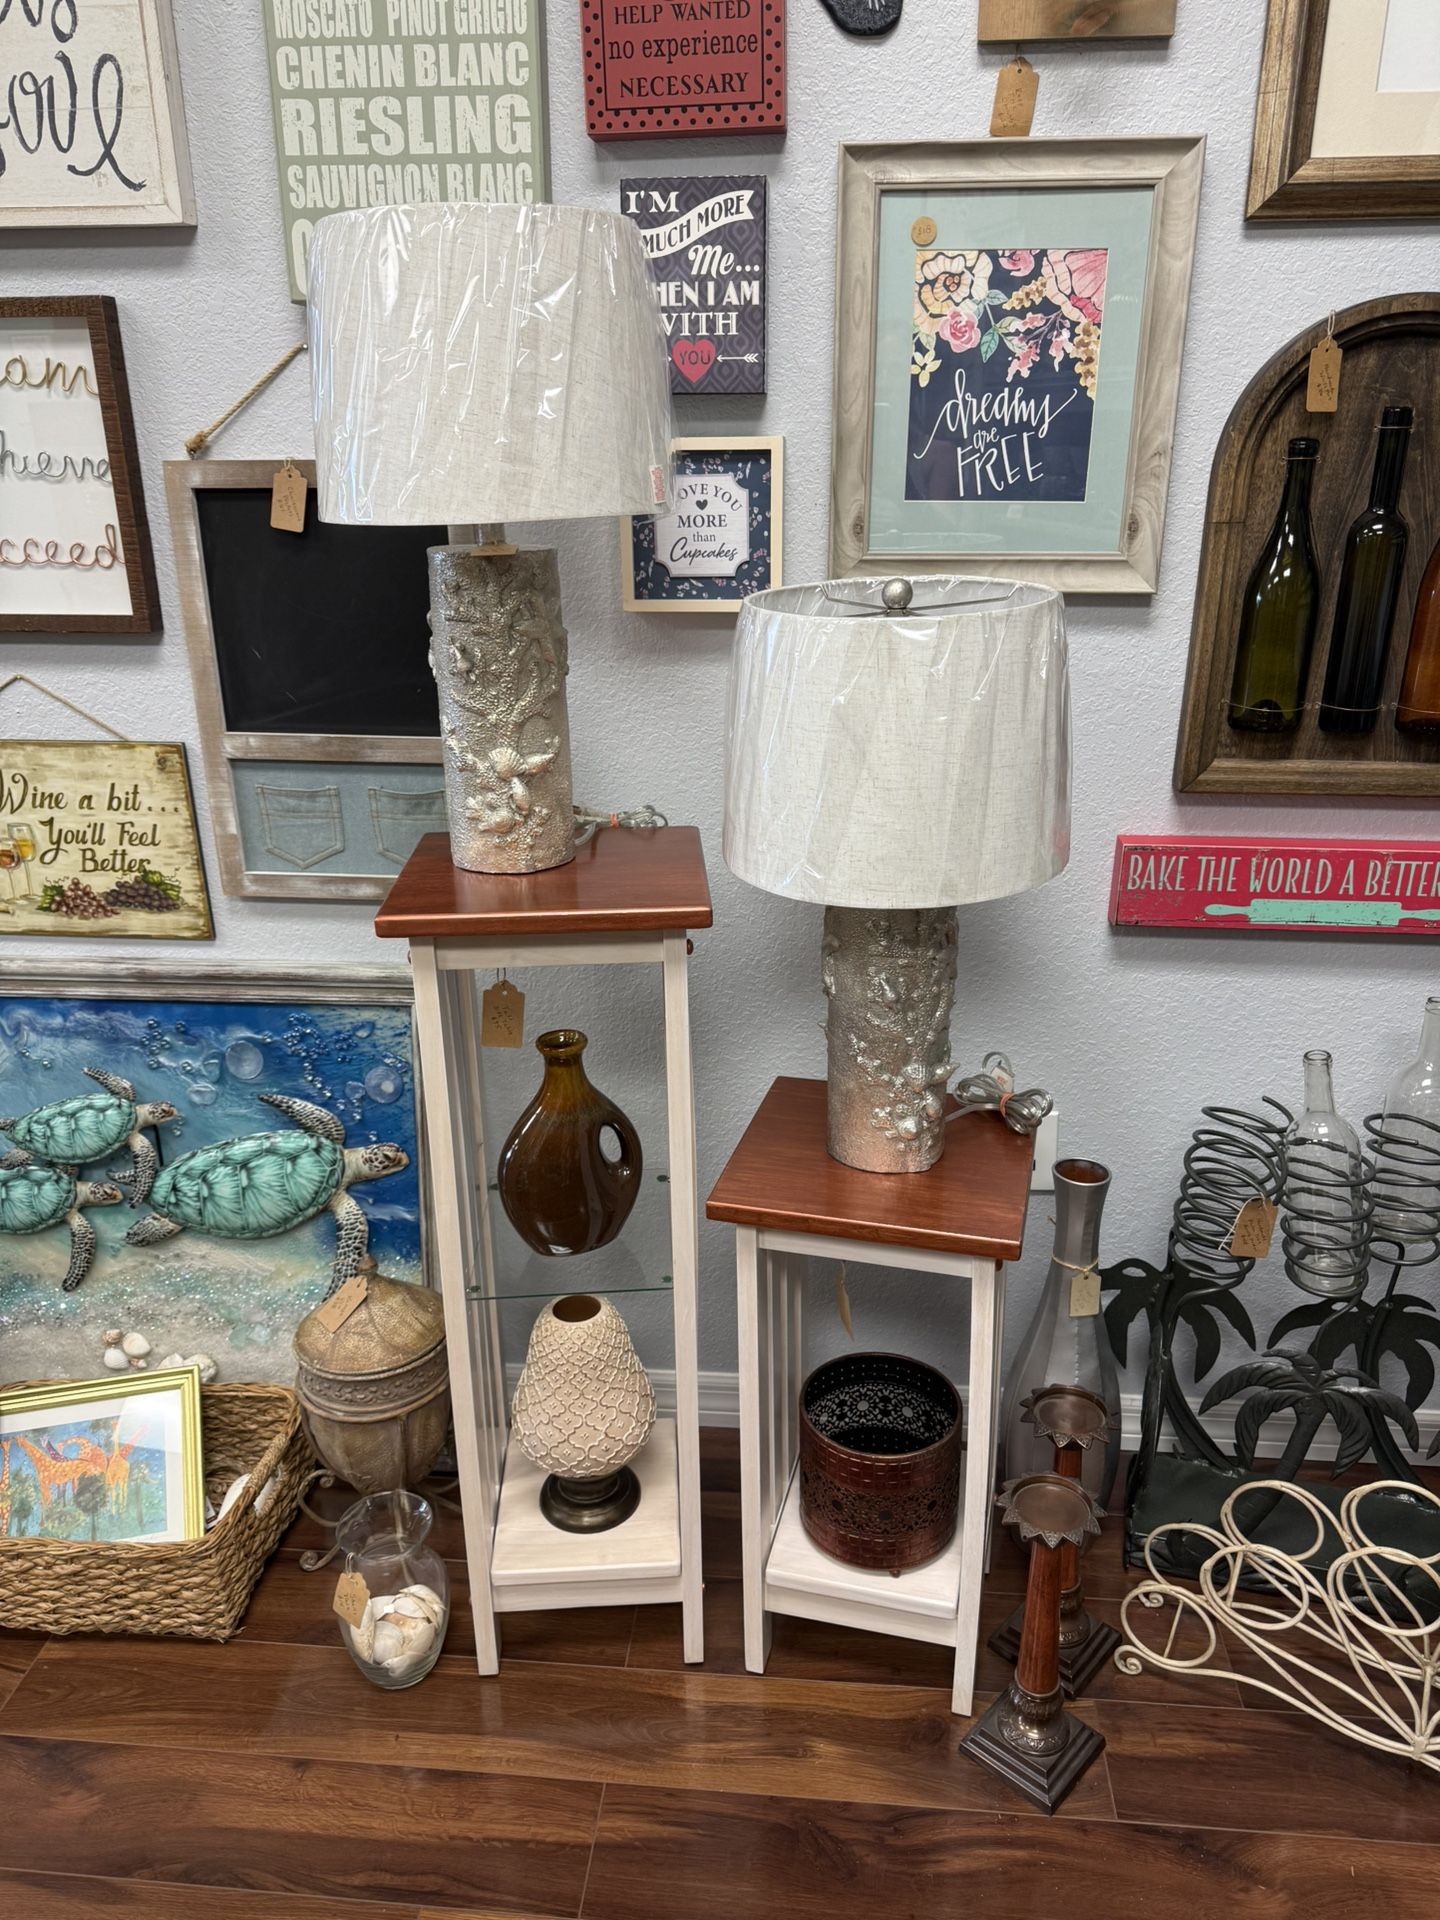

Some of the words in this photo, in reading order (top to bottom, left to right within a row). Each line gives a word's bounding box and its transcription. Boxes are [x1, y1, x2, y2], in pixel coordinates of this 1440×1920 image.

[273, 0, 373, 38] MOSCATO
[387, 0, 448, 37] PINOT
[453, 0, 528, 36] GRIGIO
[614, 4, 664, 25] HELP
[671, 0, 751, 22] WANTED
[608, 40, 634, 60] no
[642, 30, 759, 64] experience
[276, 44, 405, 90] CHENIN
[413, 41, 530, 87] BLANC
[620, 72, 750, 98] NECESSARY
[280, 94, 533, 156] RIESLING
[287, 163, 440, 208] SAUVIGNON
[446, 162, 534, 204] BLANC
[626, 190, 680, 214] I'M
[642, 219, 692, 253] MUCH
[697, 194, 746, 232] MORE
[657, 280, 699, 307] HEN
[707, 281, 715, 306] I
[722, 280, 760, 306] AM
[679, 350, 711, 366] YOU
[973, 427, 1000, 453] are
[957, 431, 1044, 497] FREE
[677, 484, 709, 500] OVE
[713, 485, 743, 512] YOU
[677, 514, 728, 529] MORE
[670, 536, 738, 566] Cupcakes
[692, 532, 717, 543] than
[0, 768, 68, 815] Wine
[79, 794, 96, 810] a
[39, 817, 106, 865] You'll
[117, 821, 162, 847] Feel
[79, 848, 152, 873] Better
[1127, 855, 1188, 892] BAKE
[1197, 856, 1242, 893] THE
[1249, 857, 1333, 895] WORLD
[1339, 859, 1355, 895] A
